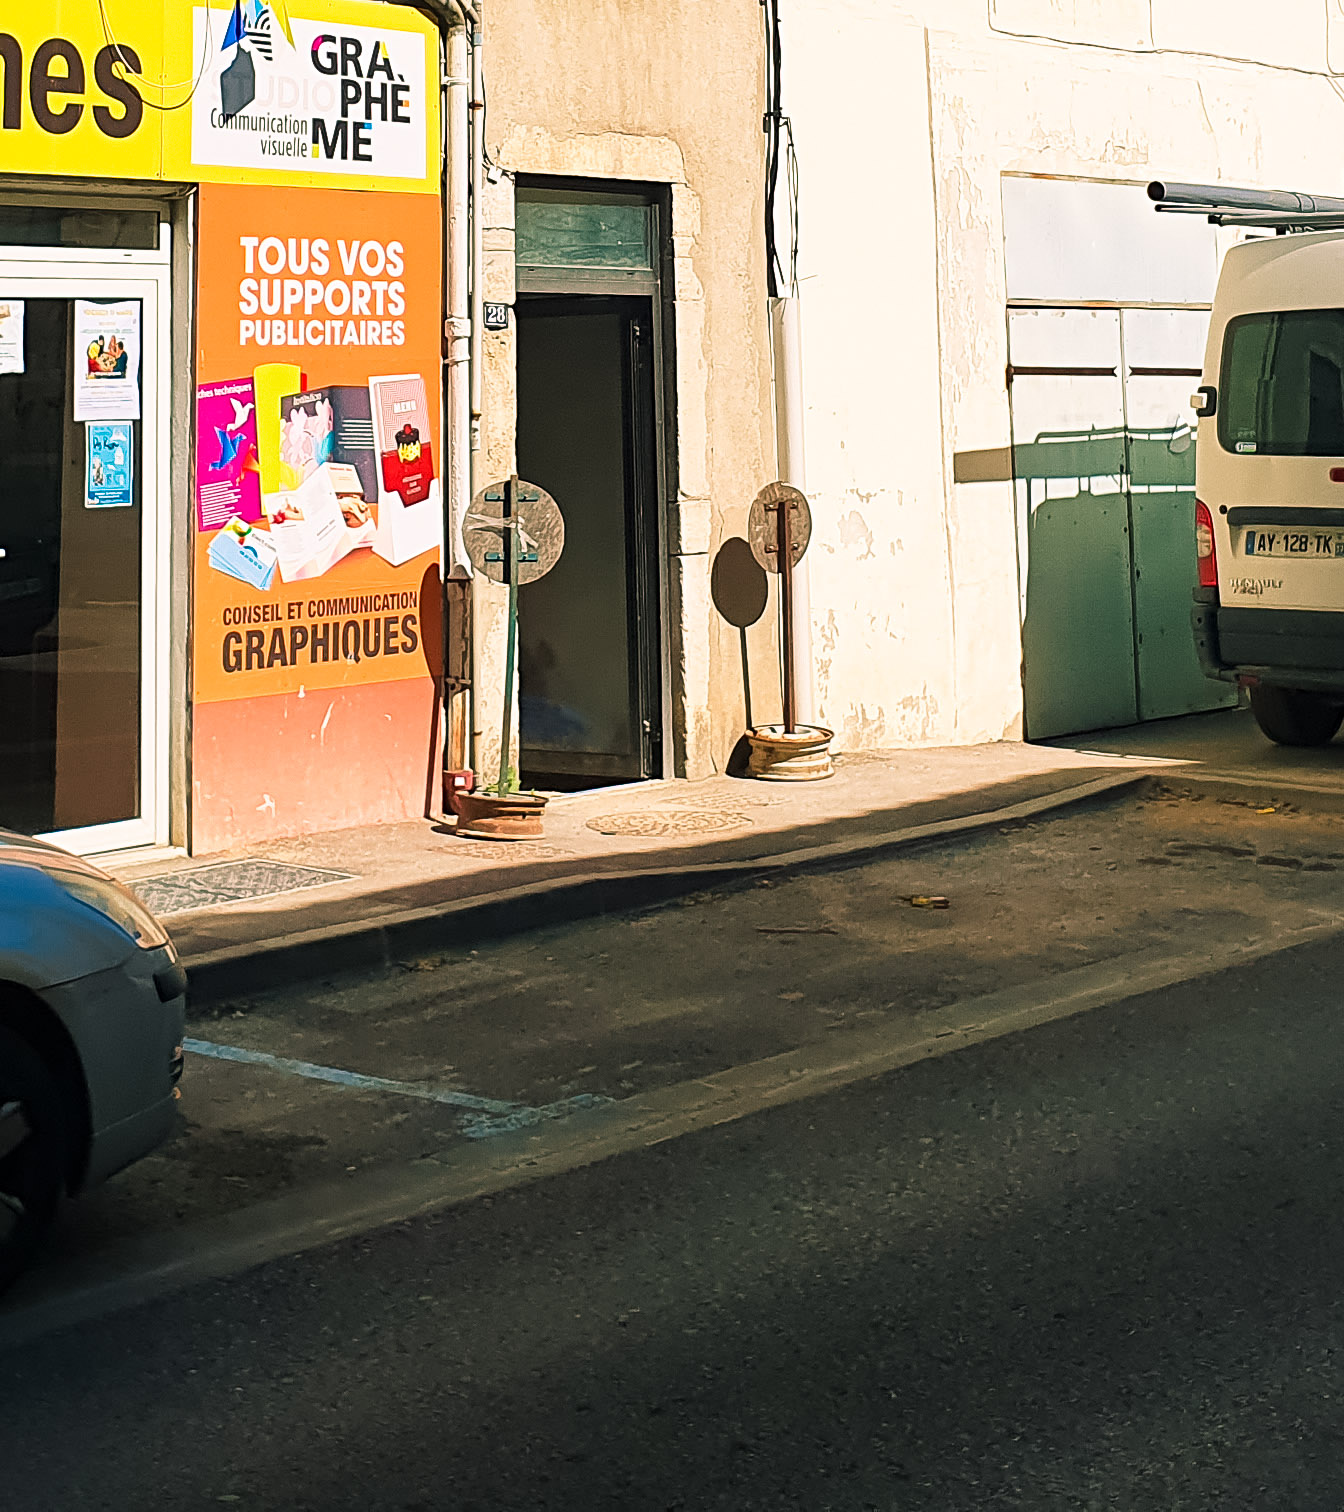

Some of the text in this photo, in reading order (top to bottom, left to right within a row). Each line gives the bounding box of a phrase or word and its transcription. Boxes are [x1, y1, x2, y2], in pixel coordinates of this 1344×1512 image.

[210, 107, 308, 135] Communication
[260, 137, 308, 158] visuelle
[239, 236, 404, 277] TOUS VOS
[239, 279, 405, 316] SUPPORTS
[487, 306, 506, 324] 28
[239, 319, 405, 346] PUBLICITAIRES
[222, 590, 418, 626] CONSEIL ET COMMUNICATION
[222, 614, 418, 674] GRAPHIQUES
